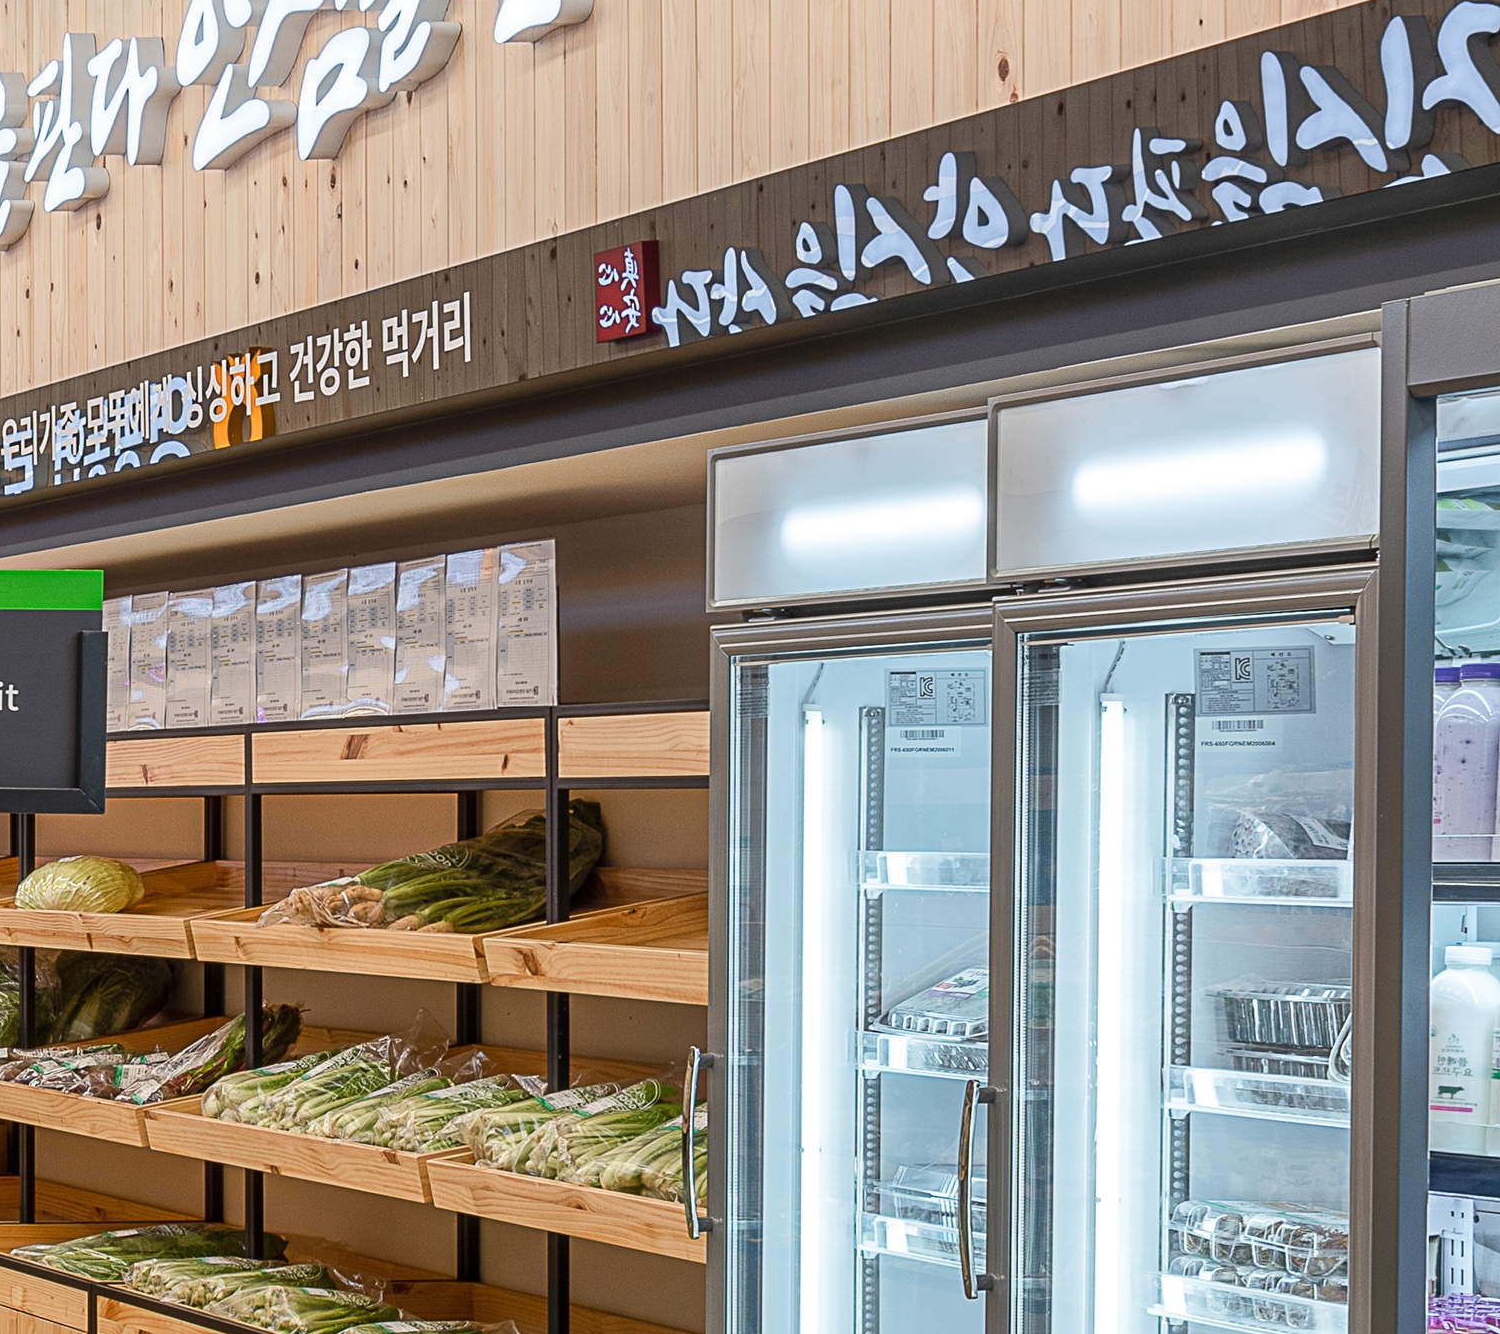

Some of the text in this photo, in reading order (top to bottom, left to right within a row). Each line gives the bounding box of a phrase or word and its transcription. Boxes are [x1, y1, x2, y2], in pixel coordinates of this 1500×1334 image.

[25, 33, 160, 213] 판다
[1, 401, 78, 472] 우리가족
[86, 373, 173, 447] 모두에게
[182, 345, 281, 429] 싱싱하고
[289, 320, 373, 403] 건강한
[381, 291, 473, 378] 먹거리
